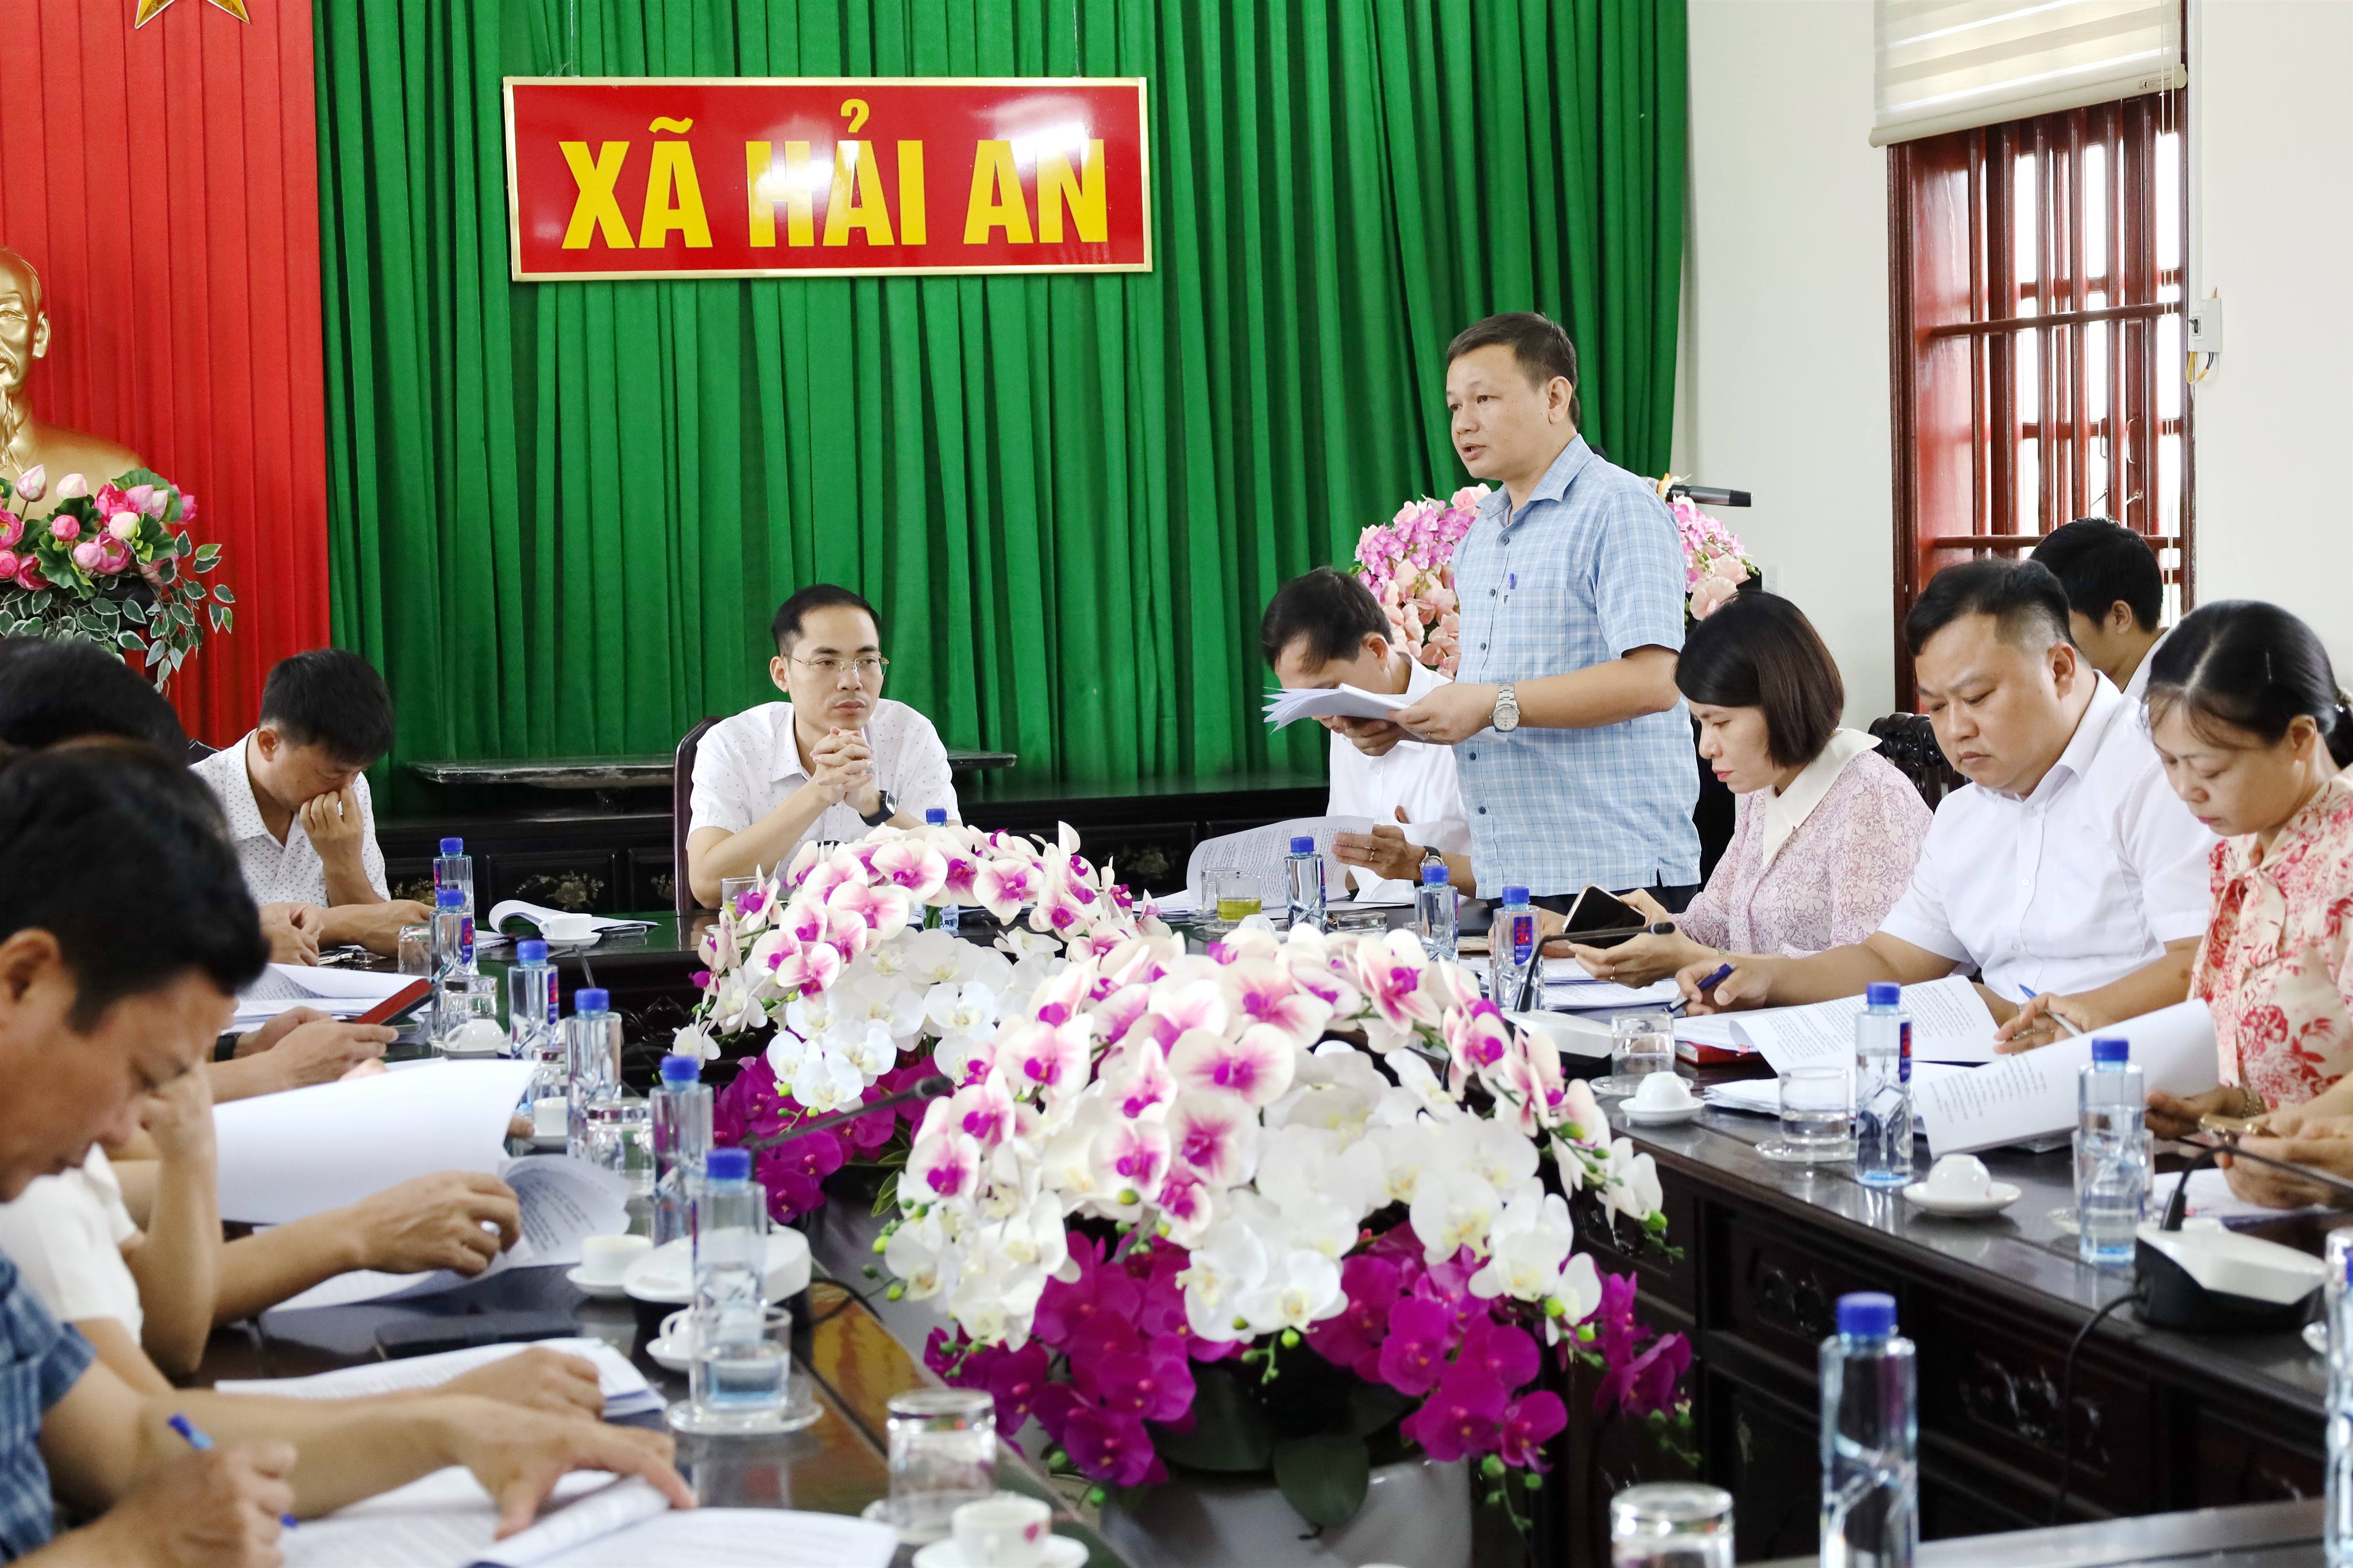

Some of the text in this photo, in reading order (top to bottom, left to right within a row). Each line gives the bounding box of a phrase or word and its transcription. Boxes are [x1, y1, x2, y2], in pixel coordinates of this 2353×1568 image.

[558, 99, 1108, 249] XÃ HẢI AN
